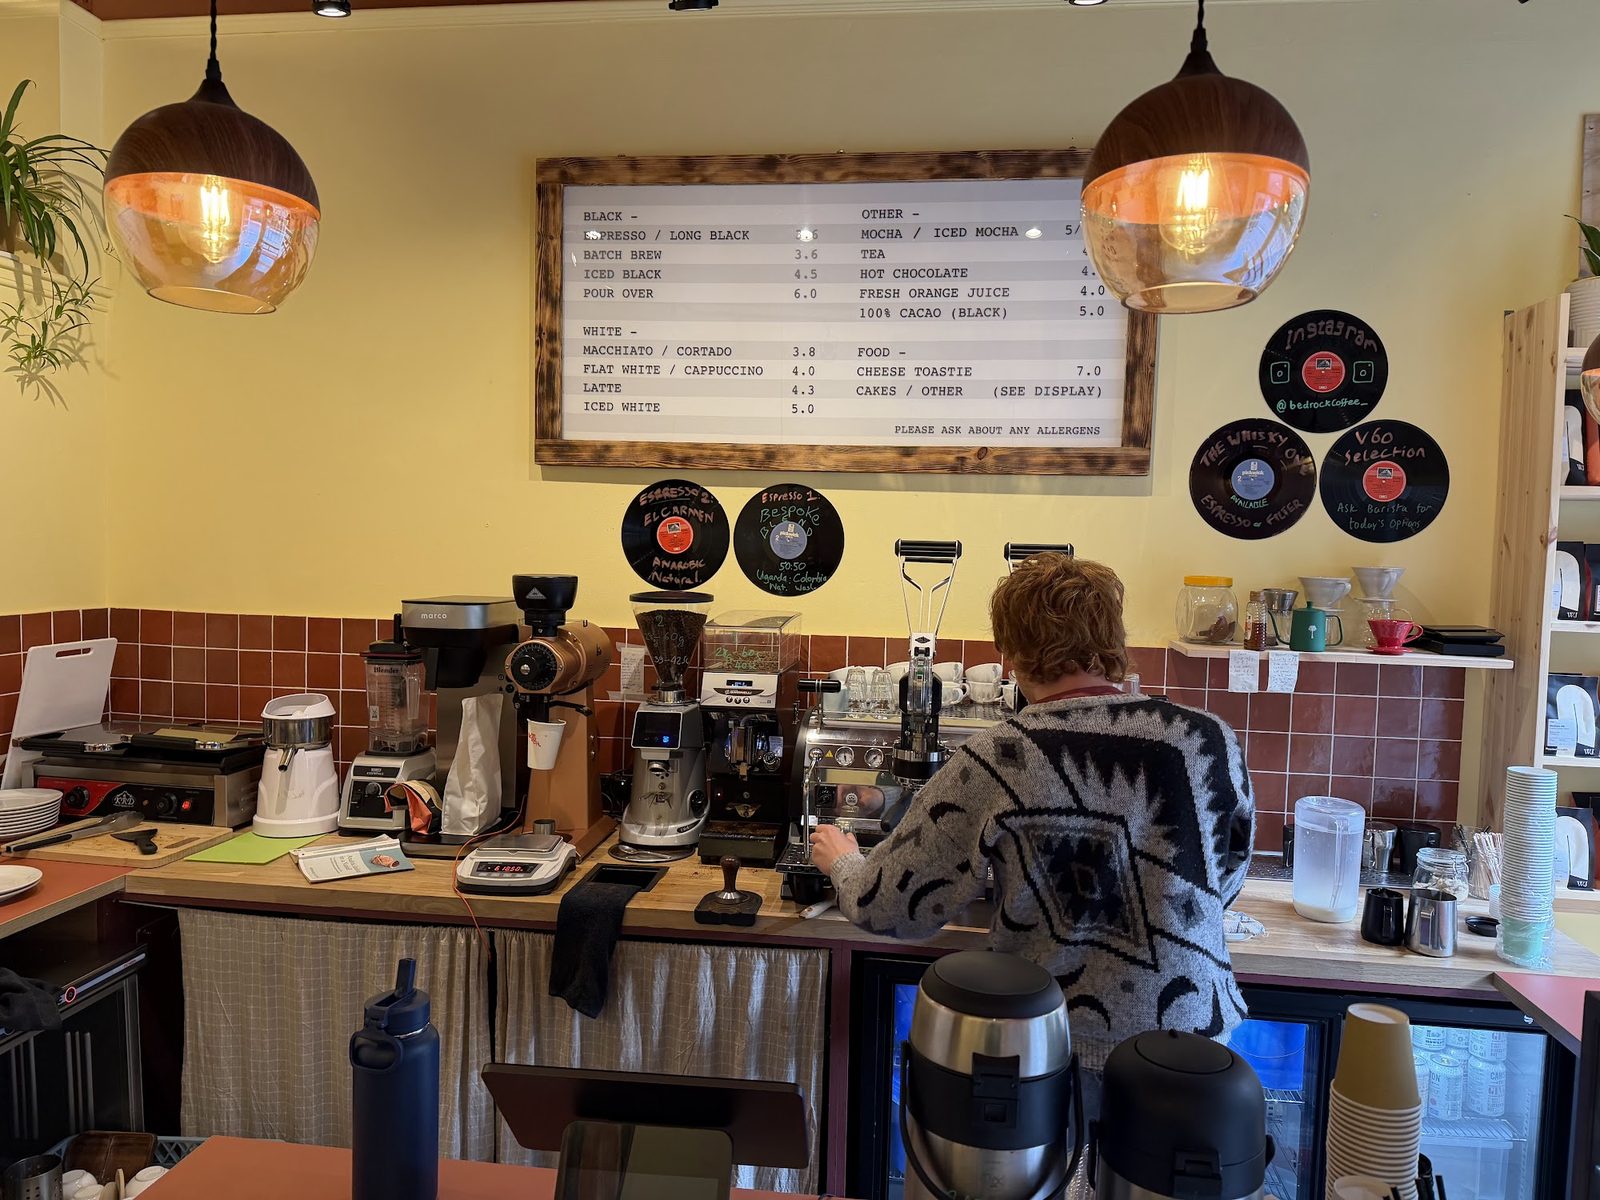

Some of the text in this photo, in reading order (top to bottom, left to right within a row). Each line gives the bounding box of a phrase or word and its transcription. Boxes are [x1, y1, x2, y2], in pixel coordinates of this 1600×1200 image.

[584, 211, 623, 222] BLACK
[861, 209, 904, 220] OTHER
[654, 230, 661, 241] /
[669, 230, 702, 241] LONG
[710, 230, 750, 241] BLACK
[861, 228, 903, 239] MOCHA
[912, 228, 922, 239] /
[933, 227, 968, 238] ICED
[975, 227, 1019, 238] MOCHA
[584, 249, 819, 260] BATCH BREW 3.6
[861, 249, 886, 259] TEA
[584, 269, 818, 280] ICED BLACK 4.5
[860, 268, 885, 279] HOT
[892, 268, 969, 279] CHOCOLATE
[583, 288, 818, 299] POUR OVER 6.0
[859, 285, 1105, 299] FRESH ORANGE JUICE 4.0
[859, 306, 1105, 320] 100% CACAO (BLACK) 5.0
[583, 326, 622, 336] WHITE
[583, 345, 817, 357] MACCHIATO / CORTADO 3.8
[857, 347, 891, 357] FOOD
[583, 364, 816, 376] FLAT WHITE / CAPPUCCINO 4.0
[856, 366, 1101, 377] CHEESE TOASTIE 7.0
[583, 383, 816, 395] LATTE 4.3
[856, 385, 1102, 398] CAKES / OTHER (SEE DISPLAY)
[583, 402, 815, 414] ICED WHITE 5.0
[894, 425, 1101, 436] PLEASE ASK ABOUT ANY ALLERGENS
[1355, 427, 1394, 445] V60
[1200, 440, 1226, 467] THE
[1227, 430, 1289, 447] WHISKY
[640, 486, 699, 506] ESPRESSO
[1230, 494, 1269, 509] AVAILABLE
[1200, 494, 1251, 528] ESPRESSO
[1266, 499, 1304, 525] FILTER
[1337, 502, 1433, 514] Ask Barista for
[644, 505, 715, 527] EL CARMEN
[779, 561, 806, 571] 50:50
[374, 666, 399, 674] Blender
